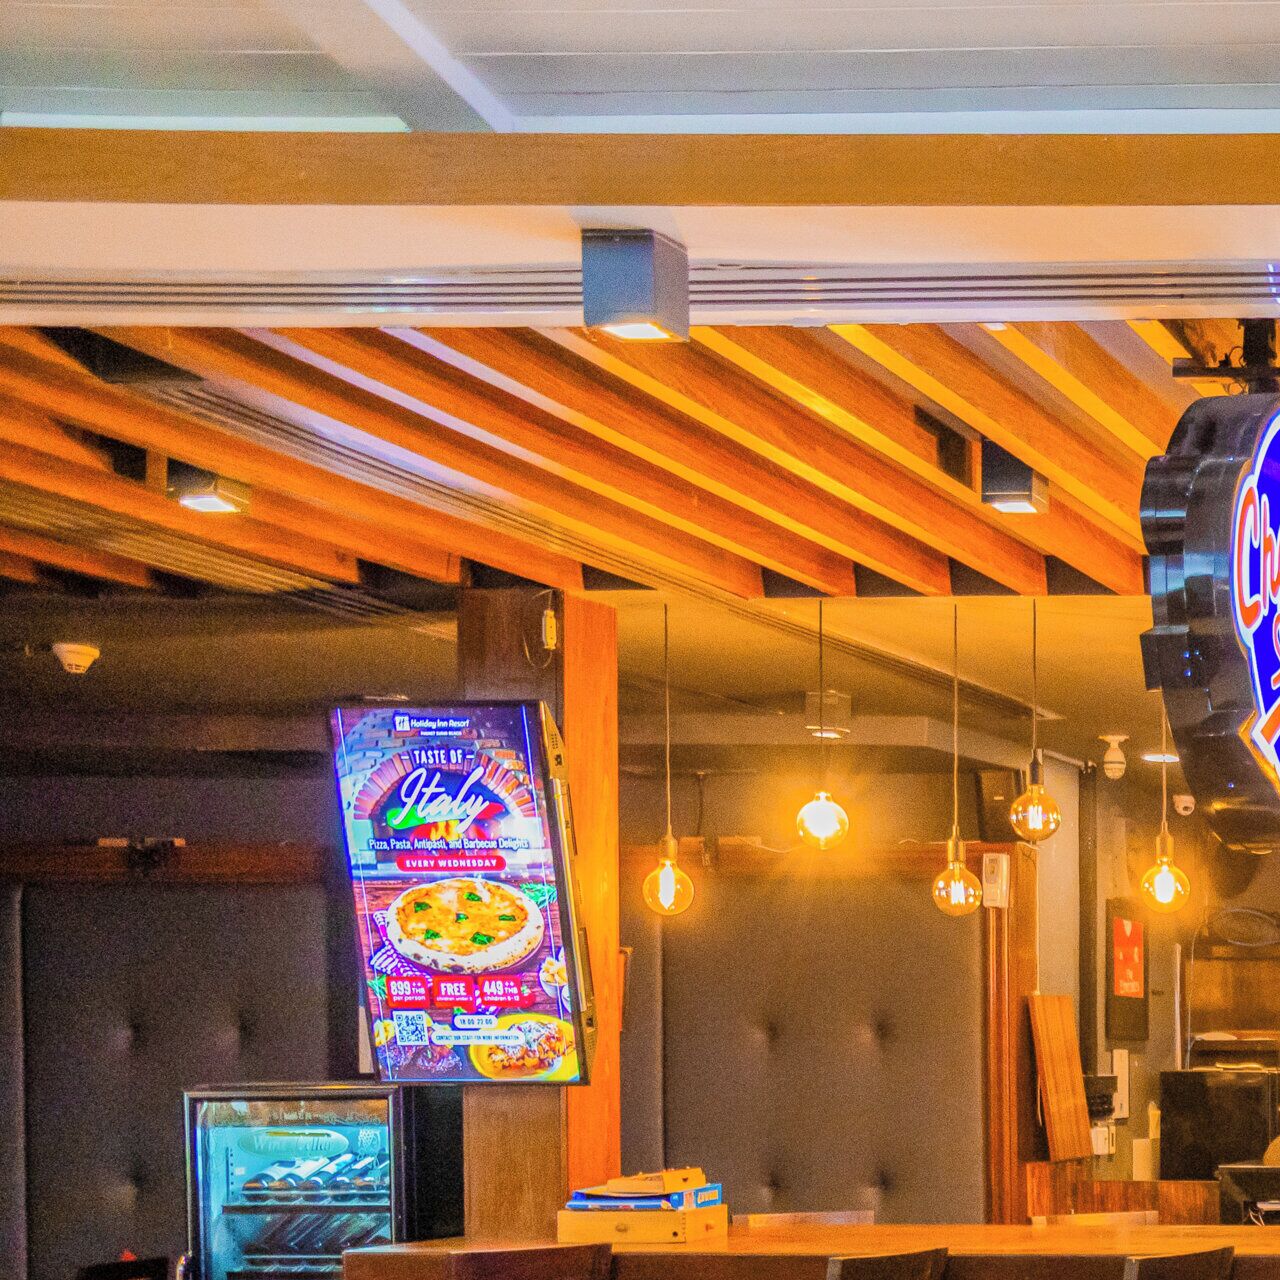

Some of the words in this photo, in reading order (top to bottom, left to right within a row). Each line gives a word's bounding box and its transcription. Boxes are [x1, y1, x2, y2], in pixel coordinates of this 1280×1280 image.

[411, 719, 436, 729] Holiday
[437, 719, 448, 728] Inn
[449, 719, 470, 728] Resort
[413, 750, 447, 764] TASTE
[450, 750, 463, 764] OF
[392, 766, 490, 833] Italy
[368, 839, 389, 850] Pizza,
[390, 839, 413, 850] Pasta,
[414, 839, 447, 850] Antipasti,
[449, 839, 462, 849] and
[464, 838, 498, 849] Barbecue
[499, 838, 529, 850] Delights
[405, 859, 435, 867] EVERY
[438, 859, 497, 867] WEDNESDAY
[440, 983, 467, 996] FREE
[483, 980, 504, 995] 449
